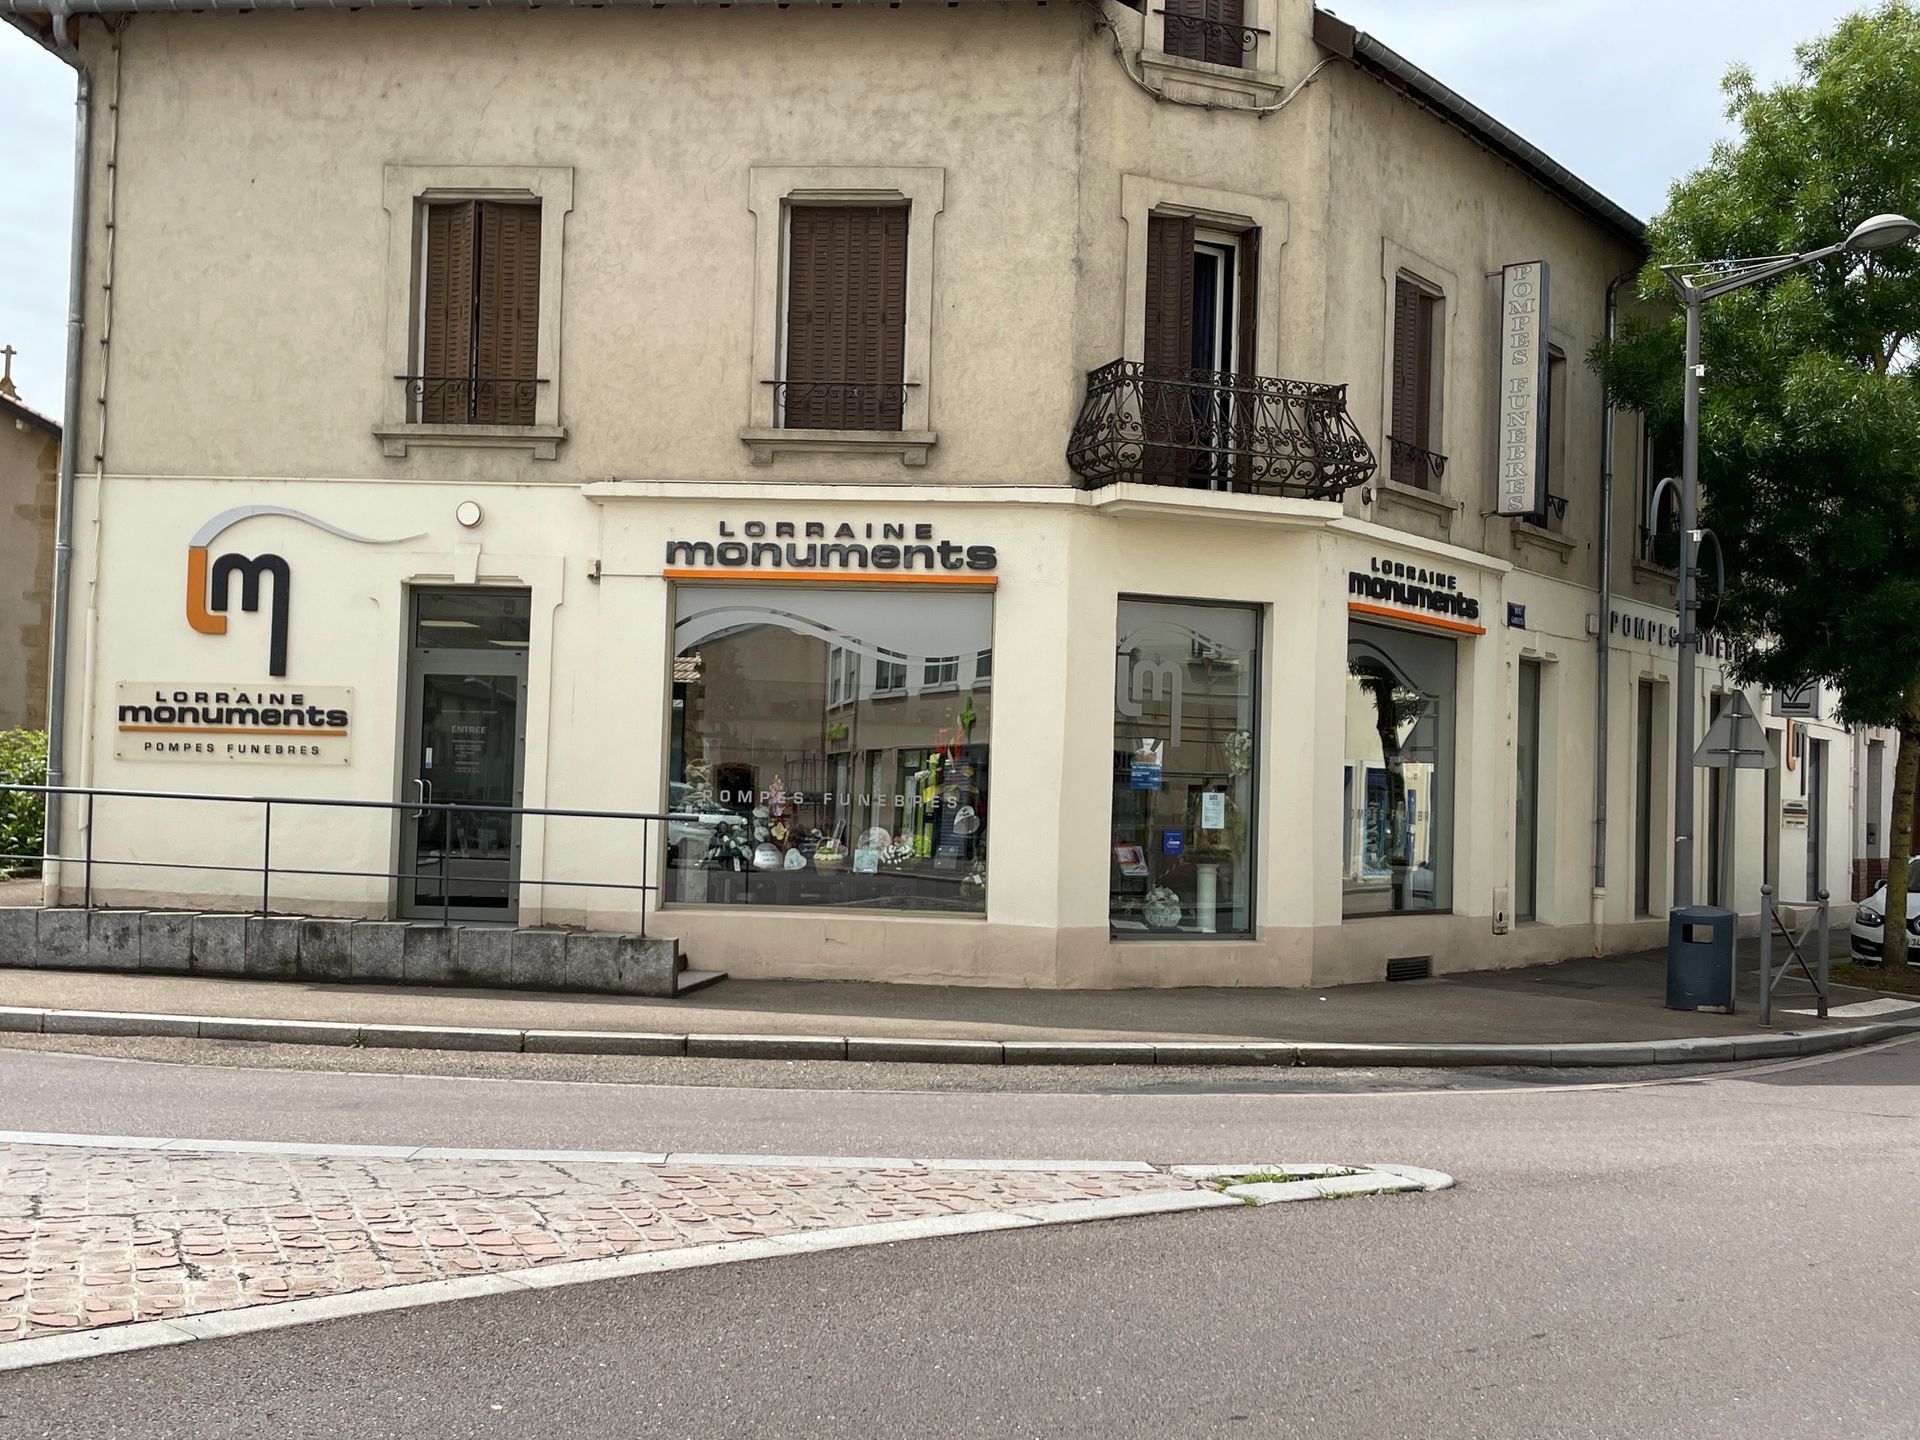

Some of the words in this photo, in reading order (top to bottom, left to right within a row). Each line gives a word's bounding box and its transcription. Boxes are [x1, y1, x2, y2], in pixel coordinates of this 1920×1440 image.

[1508, 265, 1535, 366] POMPES
[1505, 377, 1529, 512] FUNEBRES
[719, 520, 933, 540] LORRAINE
[666, 540, 998, 570] monuments
[1371, 557, 1457, 590] LORRAINE
[1349, 571, 1479, 619] monuments
[1610, 611, 1678, 648] POMPES
[155, 691, 304, 705] LORRAINE
[118, 705, 348, 727] monuments
[144, 742, 215, 753] POMPES
[227, 743, 320, 755] FUNEBRES
[702, 789, 804, 804] POMPES
[823, 792, 958, 809] FUNEBRES
